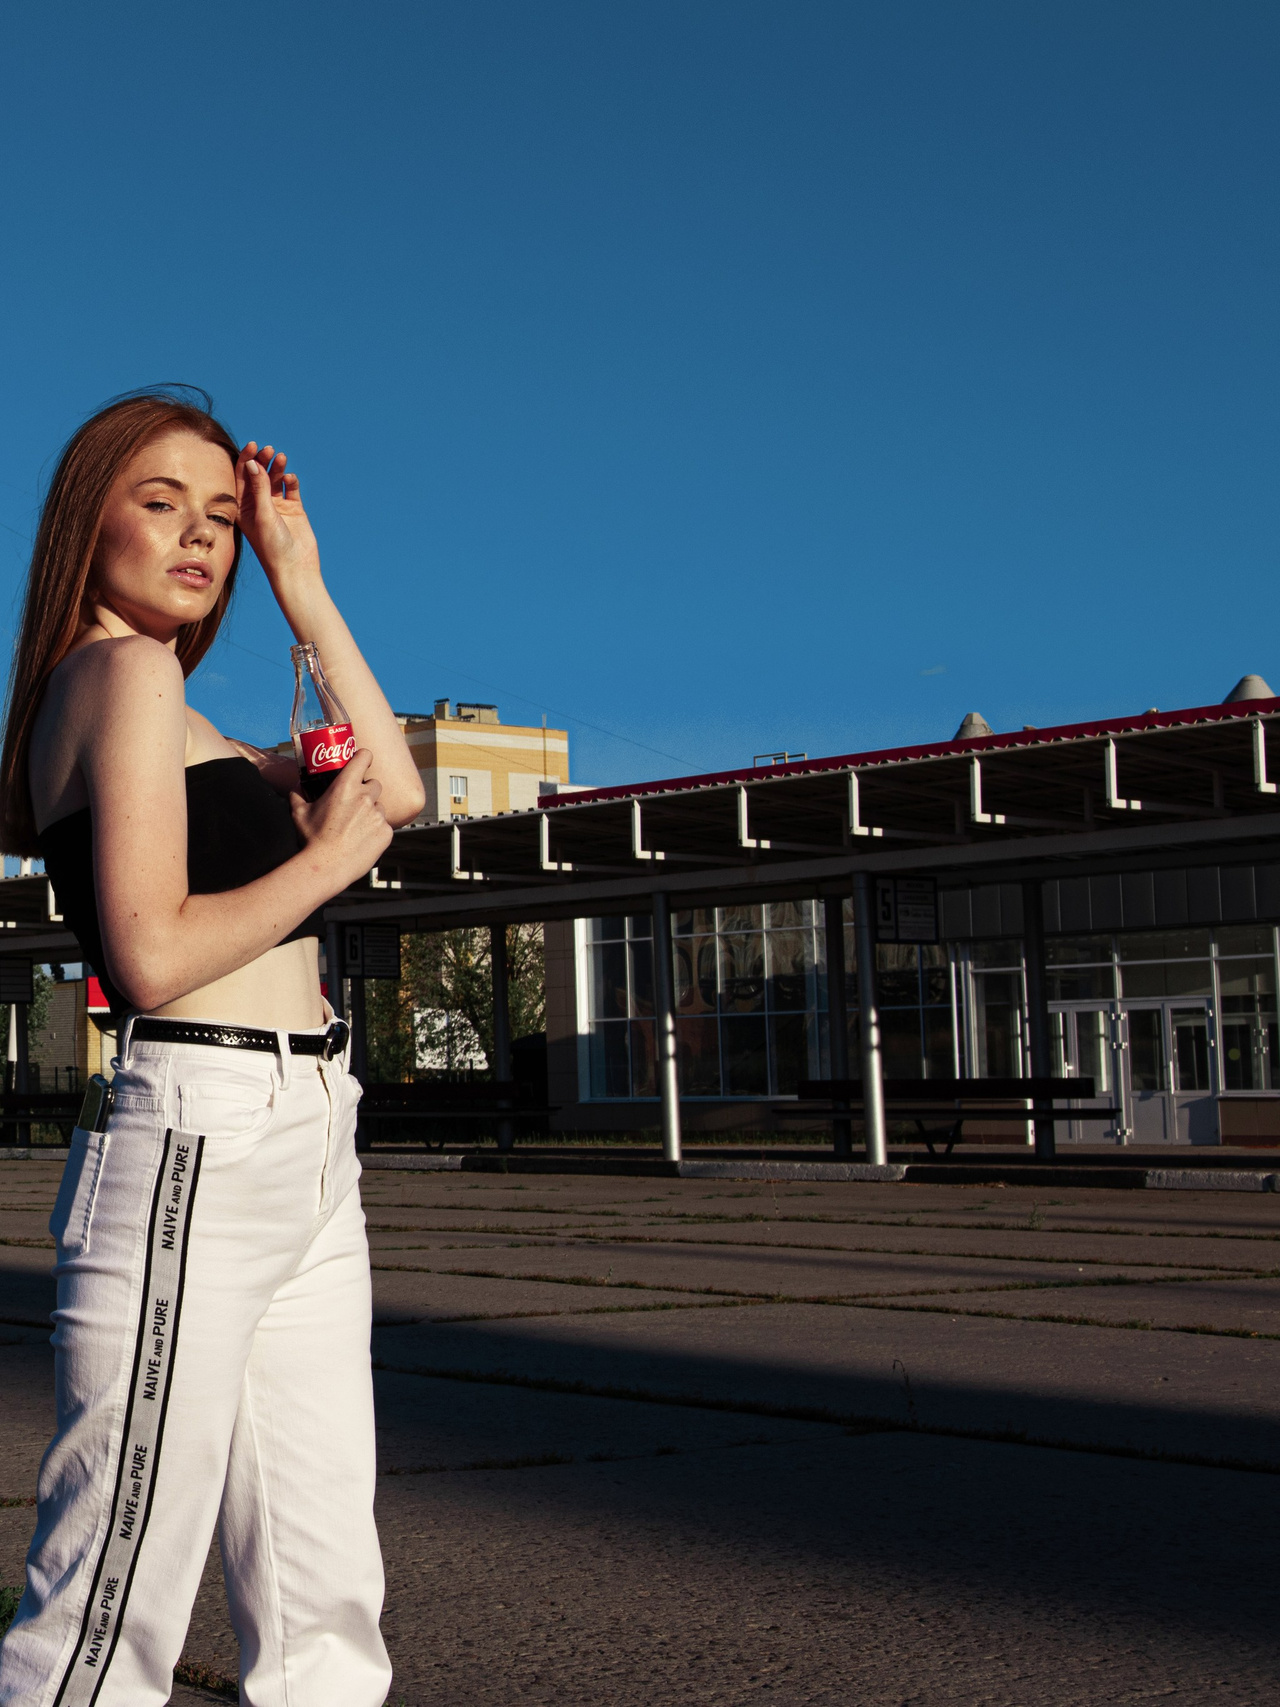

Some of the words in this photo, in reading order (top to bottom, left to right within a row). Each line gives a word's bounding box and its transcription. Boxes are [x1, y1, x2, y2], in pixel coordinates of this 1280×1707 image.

[328, 725, 348, 735] CLASSIC
[881, 888, 892, 921] 5
[349, 934, 358, 961] 6
[171, 1144, 190, 1183] PURE
[171, 1184, 183, 1205] AND
[161, 1205, 178, 1250] NAIVE
[152, 1298, 169, 1337] PURE
[153, 1338, 164, 1358] AND
[142, 1358, 161, 1401] NAIVE
[130, 1444, 147, 1480] PURE
[132, 1481, 142, 1499] AND
[119, 1499, 138, 1541] NAIVE
[100, 1577, 119, 1611] PURE
[99, 1611, 110, 1628] AND
[84, 1628, 106, 1668] NAIVE
